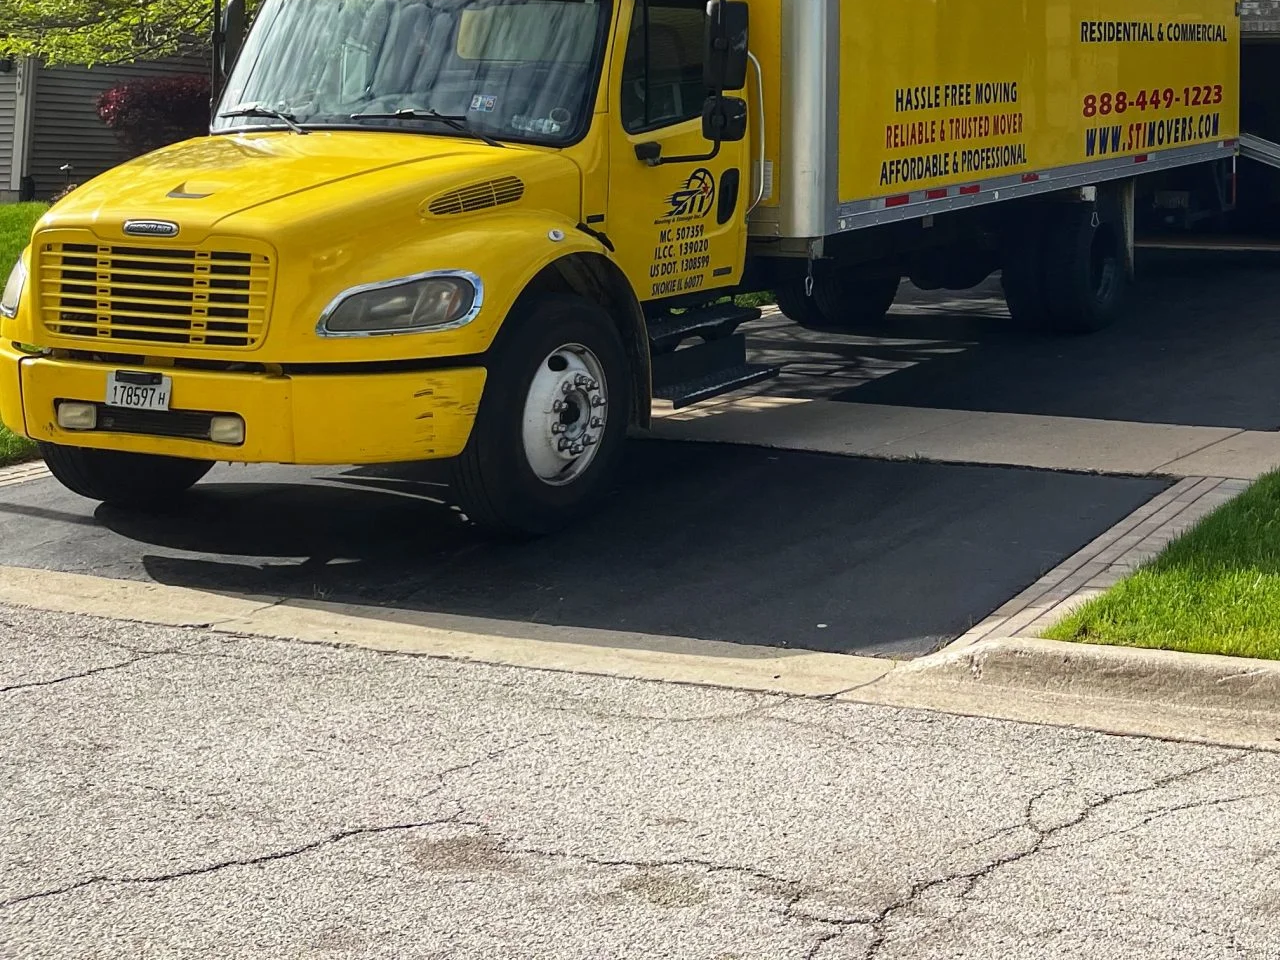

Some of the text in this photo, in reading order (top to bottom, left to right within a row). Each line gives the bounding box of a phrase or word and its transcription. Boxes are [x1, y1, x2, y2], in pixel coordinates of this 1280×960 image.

[1080, 21, 1228, 42] RESIDENTIAL & COMMERCIAL
[895, 82, 1017, 112] HASSLE FREE MOVING
[1082, 84, 1223, 118] 888-449-1223
[886, 112, 1023, 149] RELIABLE & TRUSTED MOVER
[1085, 112, 1220, 157] WWW.STIMOVERS.COM
[880, 143, 1027, 186] AFFORDABLE & PROFESSIONAL
[660, 224, 704, 243] MC. 507359
[679, 239, 709, 256] 139020
[650, 264, 660, 278] US
[660, 261, 679, 276] DOT.
[651, 279, 676, 296] SKOKIE
[684, 274, 704, 289] 60077
[111, 385, 166, 408] 178597 H
